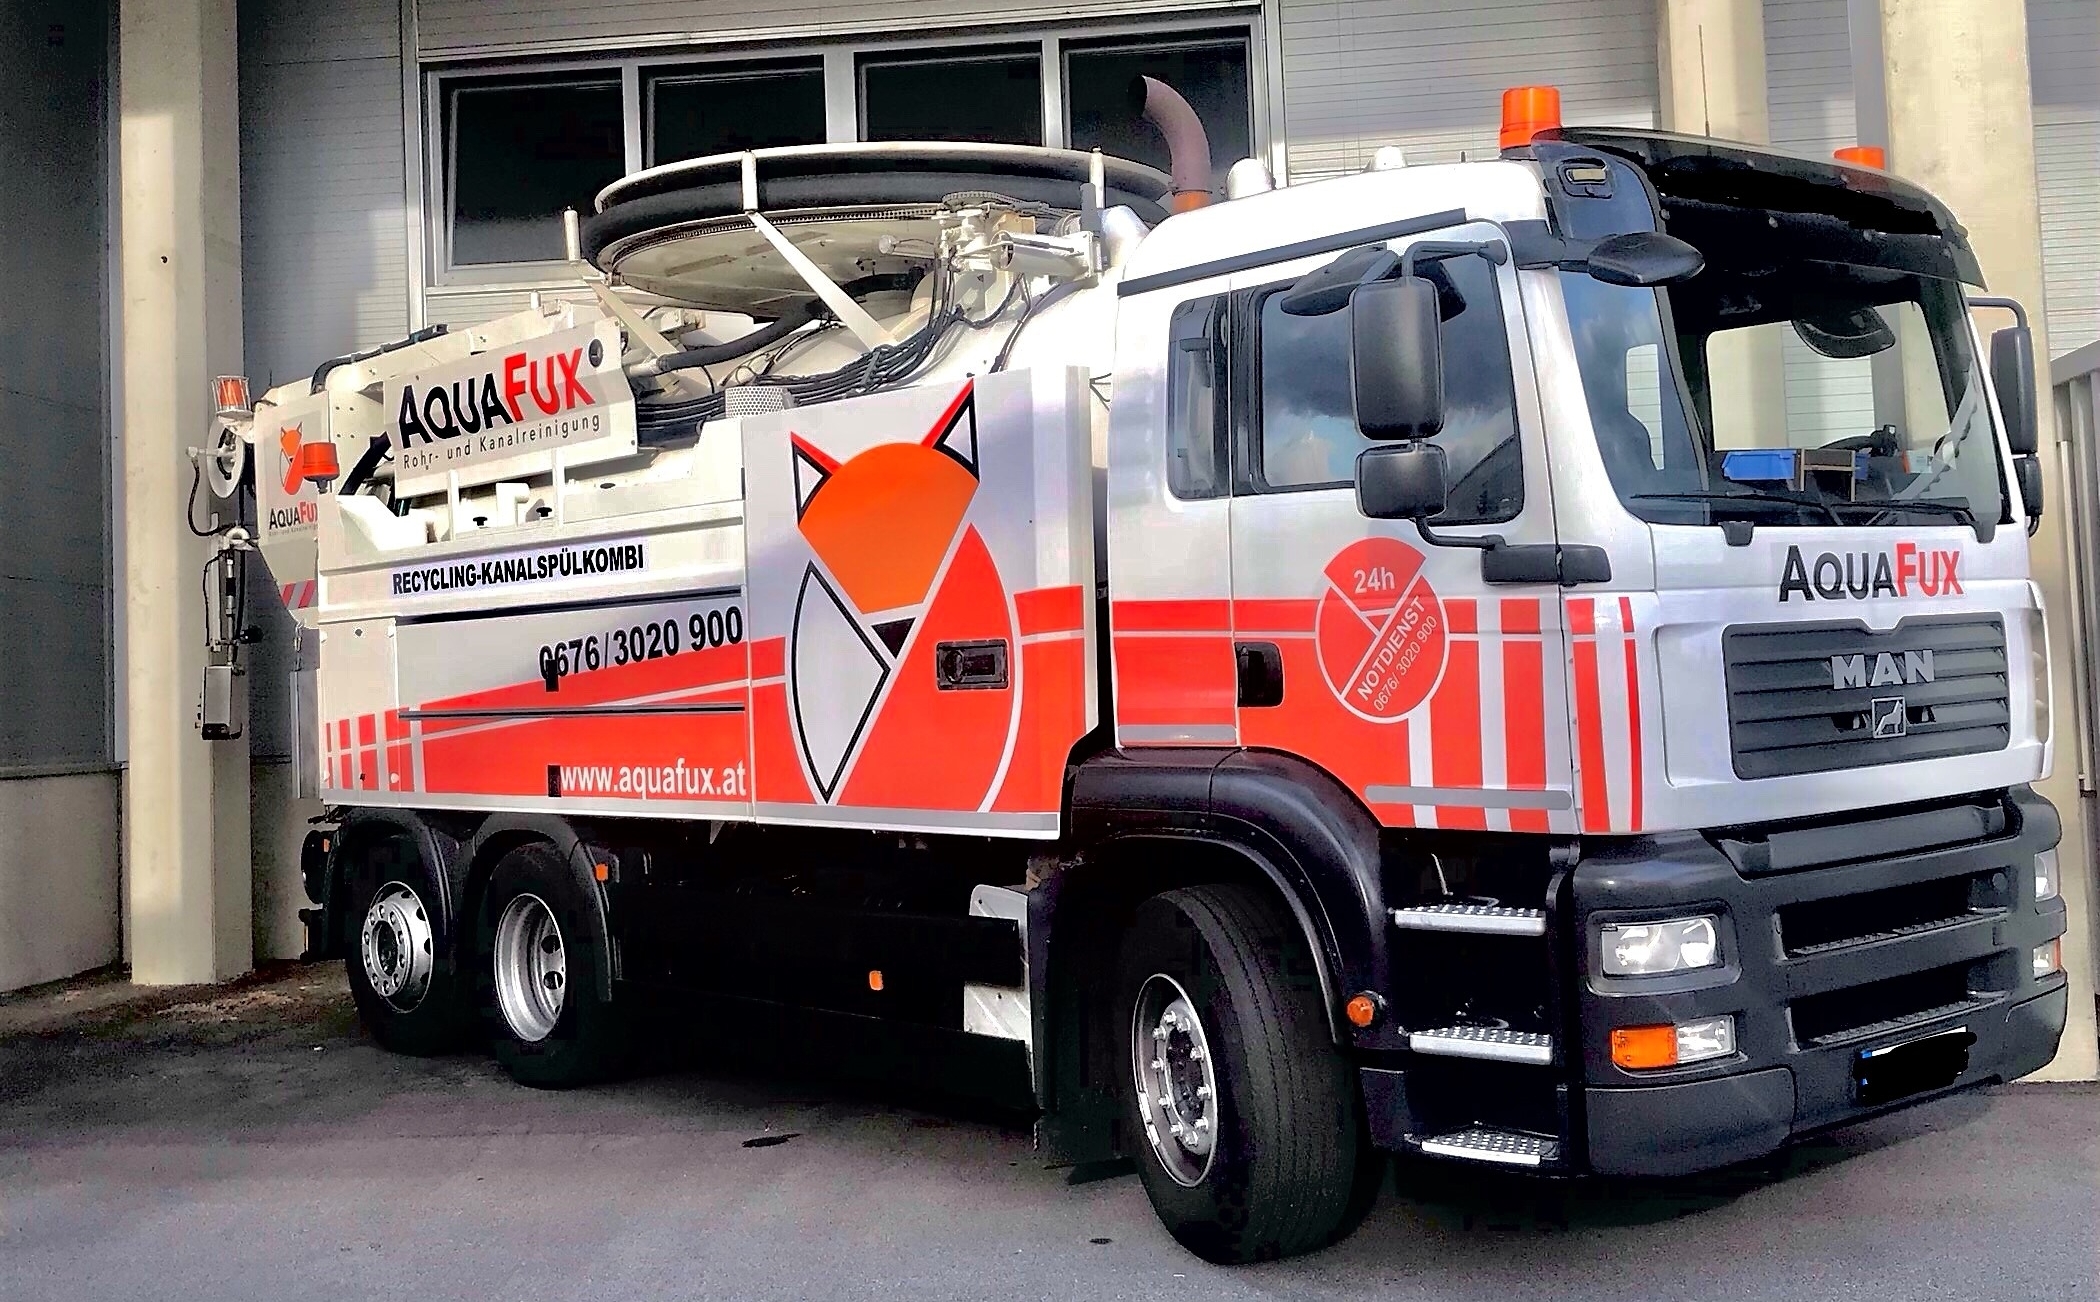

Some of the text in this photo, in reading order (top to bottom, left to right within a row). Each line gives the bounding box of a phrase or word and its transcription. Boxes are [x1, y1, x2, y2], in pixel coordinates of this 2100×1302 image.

[403, 414, 600, 470] Rohr- und Kanalreinigung
[393, 544, 643, 594] RECYCLING-KANALSPÜLKOMBI
[1353, 567, 1395, 594] 24h
[689, 606, 743, 651] 900
[1357, 595, 1425, 701] NOTDIENST
[1373, 615, 1438, 712] 0676/ 3020 900
[1831, 649, 1935, 690] MAN
[559, 757, 747, 800] www.aquafux.at
